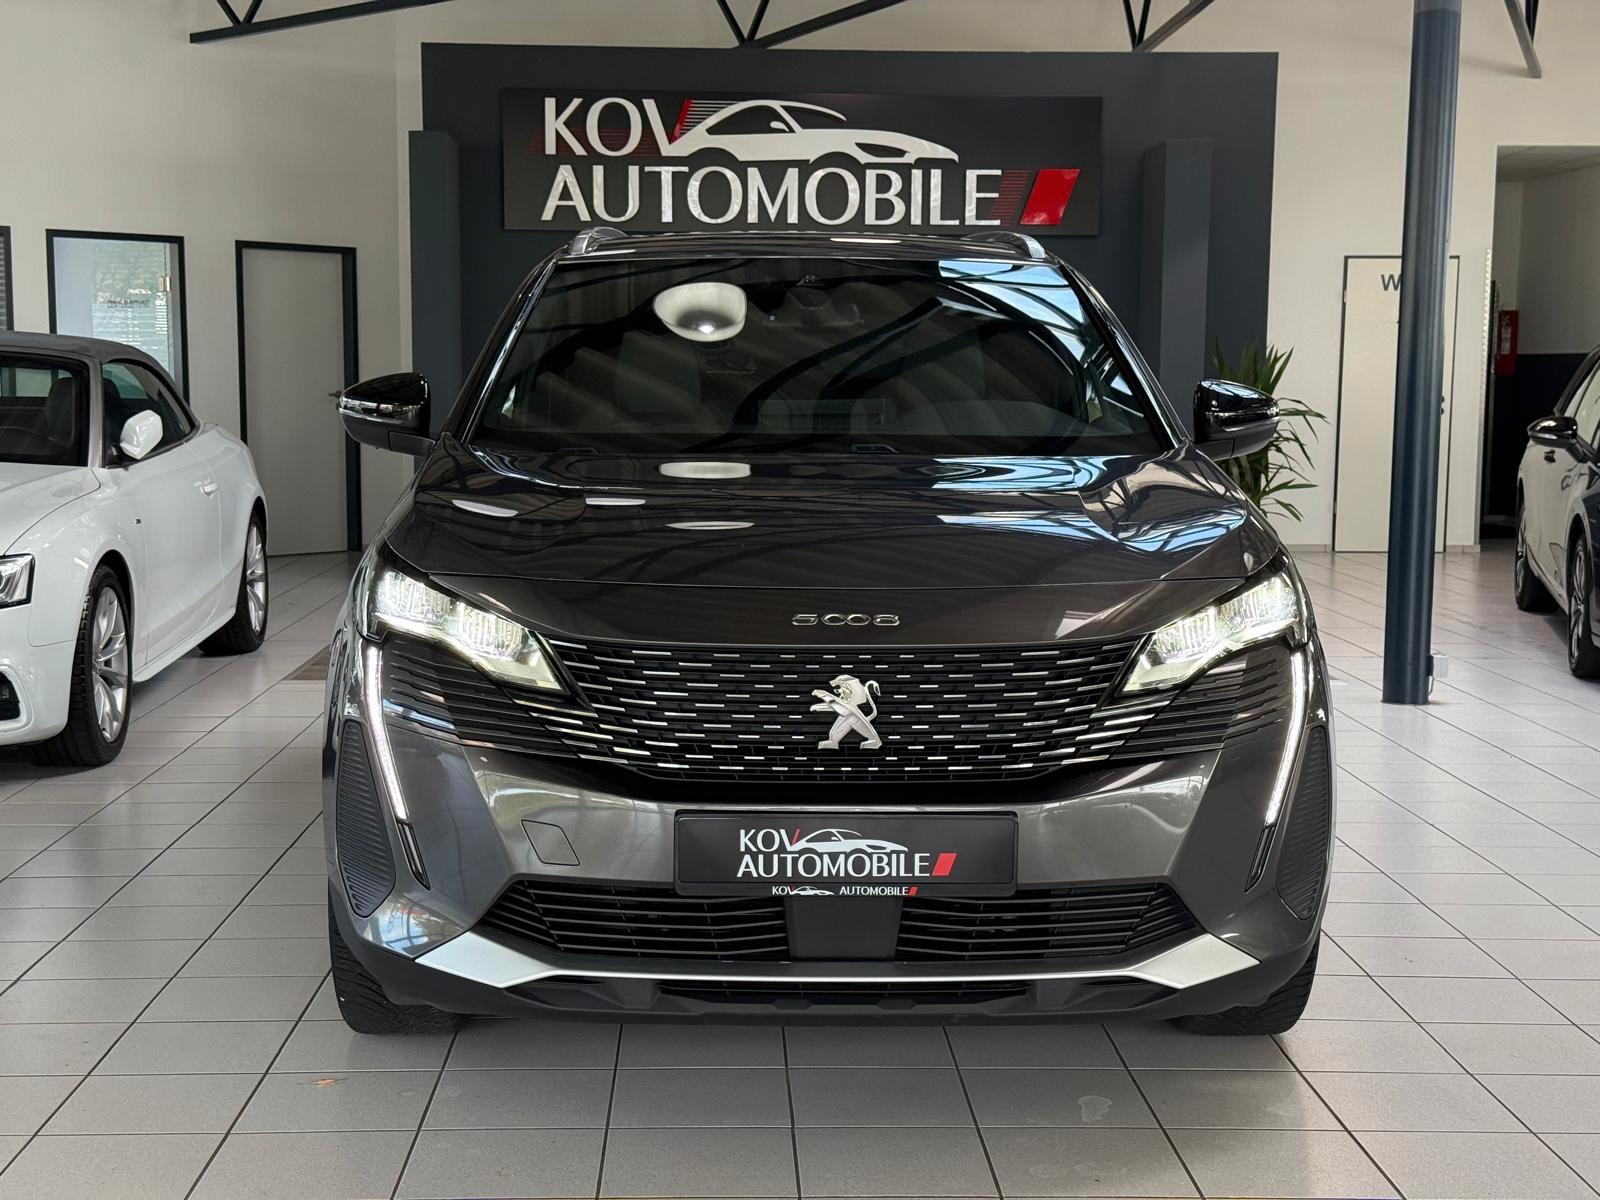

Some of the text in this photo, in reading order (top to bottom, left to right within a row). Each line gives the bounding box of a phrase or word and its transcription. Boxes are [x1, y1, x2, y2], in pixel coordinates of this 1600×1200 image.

[544, 97, 692, 157] KOV
[541, 164, 1003, 226] AUTOMOBILE
[791, 613, 901, 627] 5008
[739, 828, 800, 852] KOV
[736, 853, 931, 878] AUTOMOBILE
[772, 885, 909, 896] KOV AUTOMOBILE
